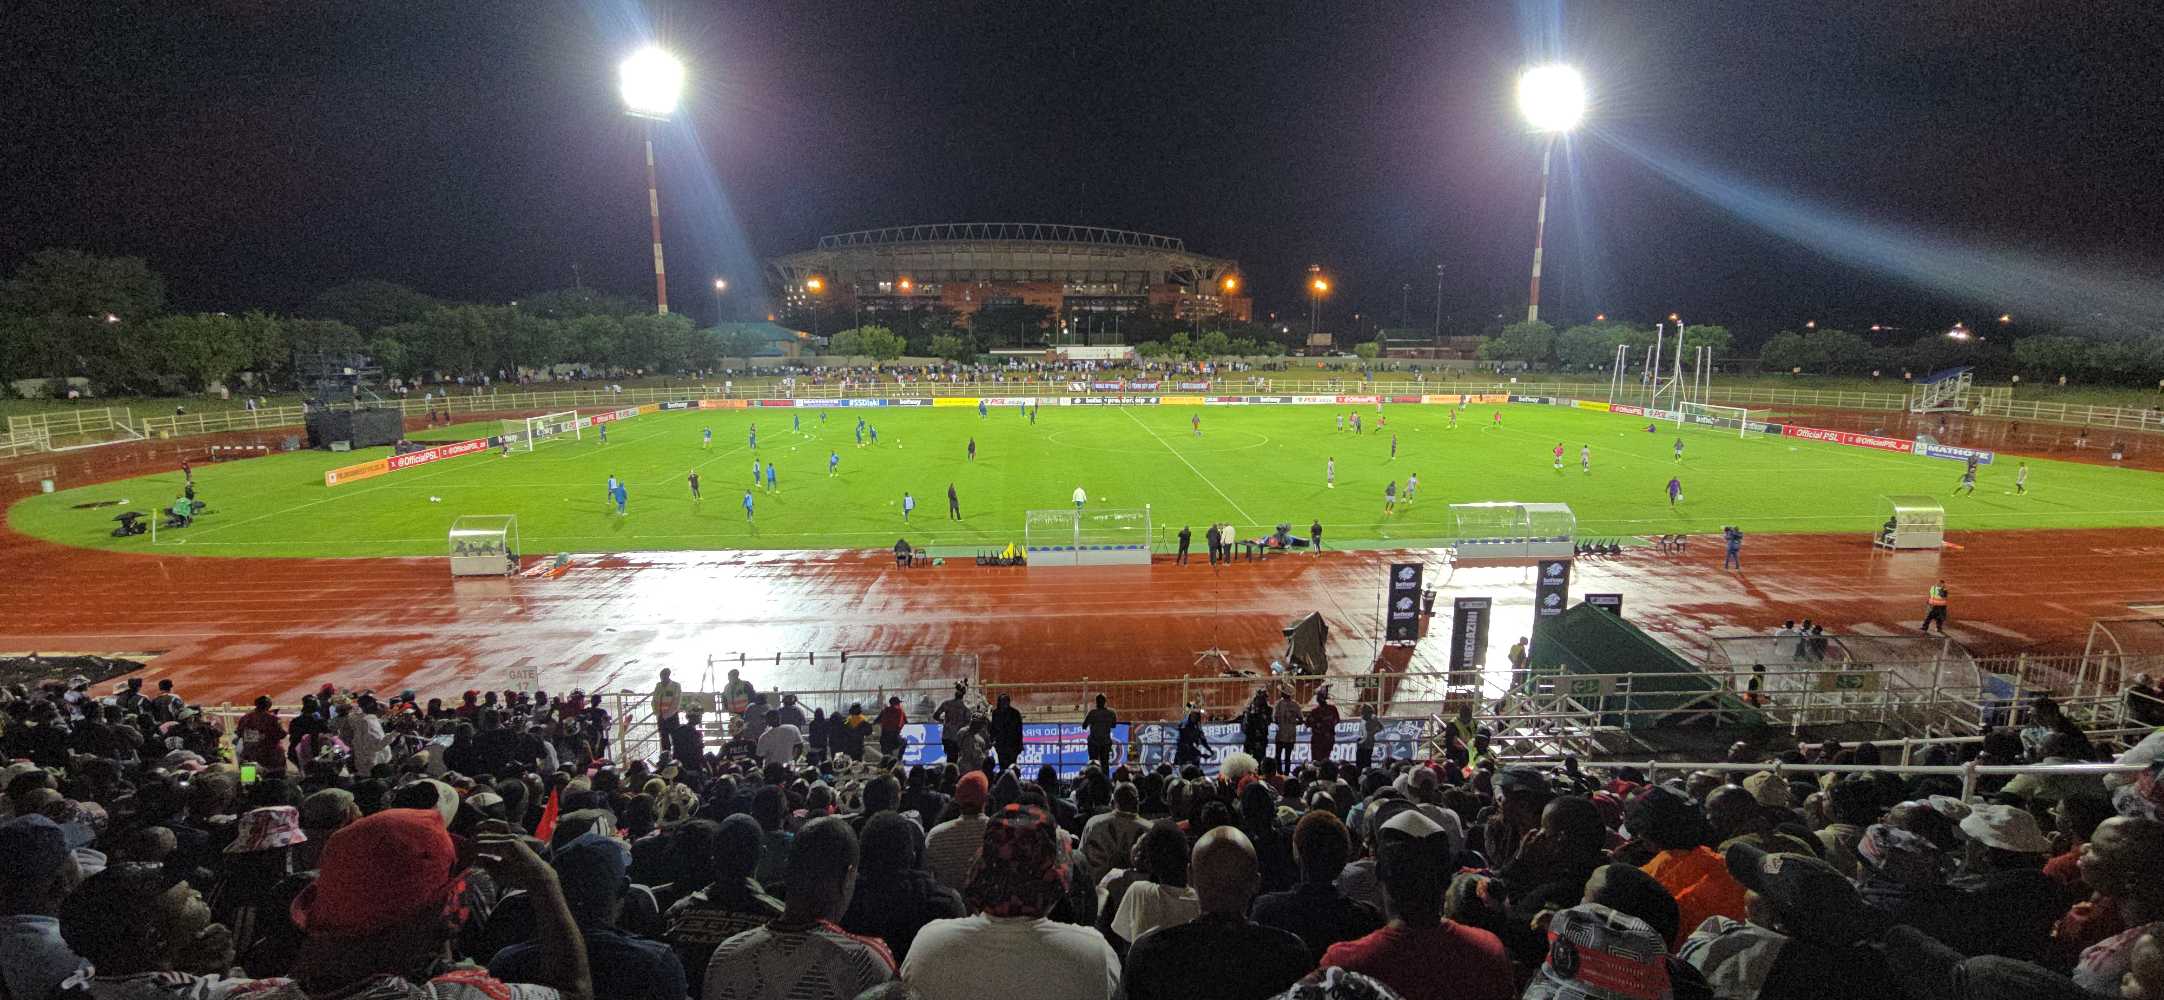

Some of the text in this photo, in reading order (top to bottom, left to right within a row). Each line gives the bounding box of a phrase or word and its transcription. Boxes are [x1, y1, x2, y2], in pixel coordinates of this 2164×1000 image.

[1797, 429, 1839, 442] Official PSL
[398, 450, 437, 467] @OfficialPSL
[508, 671, 535, 679] GATE
